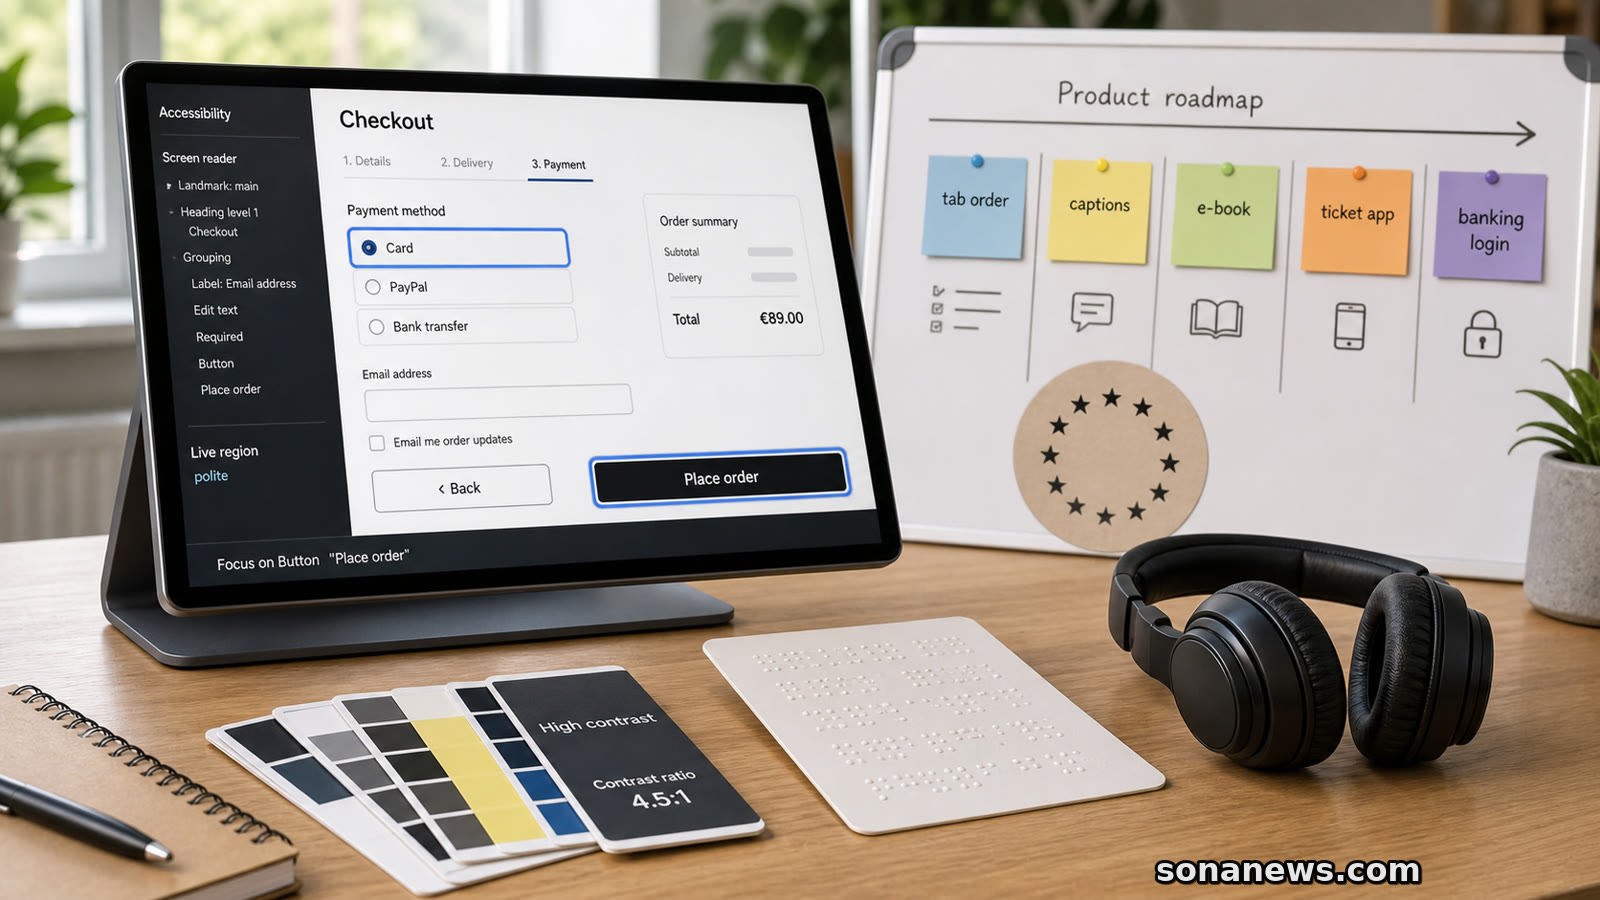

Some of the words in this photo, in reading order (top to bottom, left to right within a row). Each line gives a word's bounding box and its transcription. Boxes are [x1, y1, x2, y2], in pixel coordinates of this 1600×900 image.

[1059, 81, 1150, 106] Product
[1166, 86, 1263, 117] roadmap
[160, 107, 231, 122] Accessibility
[340, 110, 434, 130] Checkout
[163, 152, 199, 163] Screen
[203, 153, 237, 163] reader
[344, 156, 351, 165] 1.
[356, 156, 391, 166] Details
[441, 157, 450, 167] 2.
[454, 158, 493, 170] Delivery
[532, 159, 541, 168] 3.
[544, 159, 586, 171] Payment
[179, 180, 232, 190] Landmark:
[235, 181, 258, 191] main
[942, 191, 965, 205] tab
[971, 192, 1009, 207] order
[181, 207, 224, 219] Heading
[228, 207, 250, 217] level
[348, 205, 399, 218] Payment
[402, 205, 445, 216] method
[1070, 198, 1130, 215] captions
[1198, 200, 1250, 216] e-book
[1321, 205, 1362, 219] ticket
[1368, 210, 1394, 225] app
[1459, 208, 1523, 231] banking
[660, 215, 689, 226] Order
[692, 219, 738, 229] summary
[189, 226, 238, 236] Checkout
[386, 243, 413, 253] Card
[1471, 234, 1509, 255] login
[664, 247, 699, 256] Subtotal
[183, 252, 231, 265] Grouping
[192, 279, 222, 288] Label:
[226, 278, 253, 288] Email
[257, 279, 296, 288] address
[668, 273, 702, 284] Delivery
[390, 281, 427, 295] PayPal
[194, 305, 214, 315] Edit
[218, 306, 238, 315] text
[673, 313, 700, 325] Total
[760, 312, 803, 324] €89.00
[394, 321, 422, 332] Bank
[425, 320, 468, 331] transfer
[197, 332, 243, 344] Required
[199, 359, 234, 368] Button
[363, 369, 390, 379] Email
[393, 369, 432, 379] address
[201, 385, 230, 395] Place
[233, 384, 261, 394] order
[394, 437, 421, 447] Email
[443, 435, 470, 446] order
[473, 434, 512, 446] updates
[191, 447, 216, 458] Live
[220, 445, 258, 460] region
[195, 470, 228, 485] polite
[685, 472, 720, 485] Place
[724, 470, 758, 483] order
[451, 482, 480, 494] Back
[218, 559, 255, 570] Focus
[259, 559, 274, 568] on
[278, 556, 319, 567] Button
[330, 552, 368, 564] "Place
[372, 549, 409, 562] order"
[539, 721, 582, 733] High
[586, 714, 657, 728] contrast
[593, 775, 659, 789] Contrast
[661, 771, 695, 781] ratio
[633, 790, 691, 808] 4.5:1
